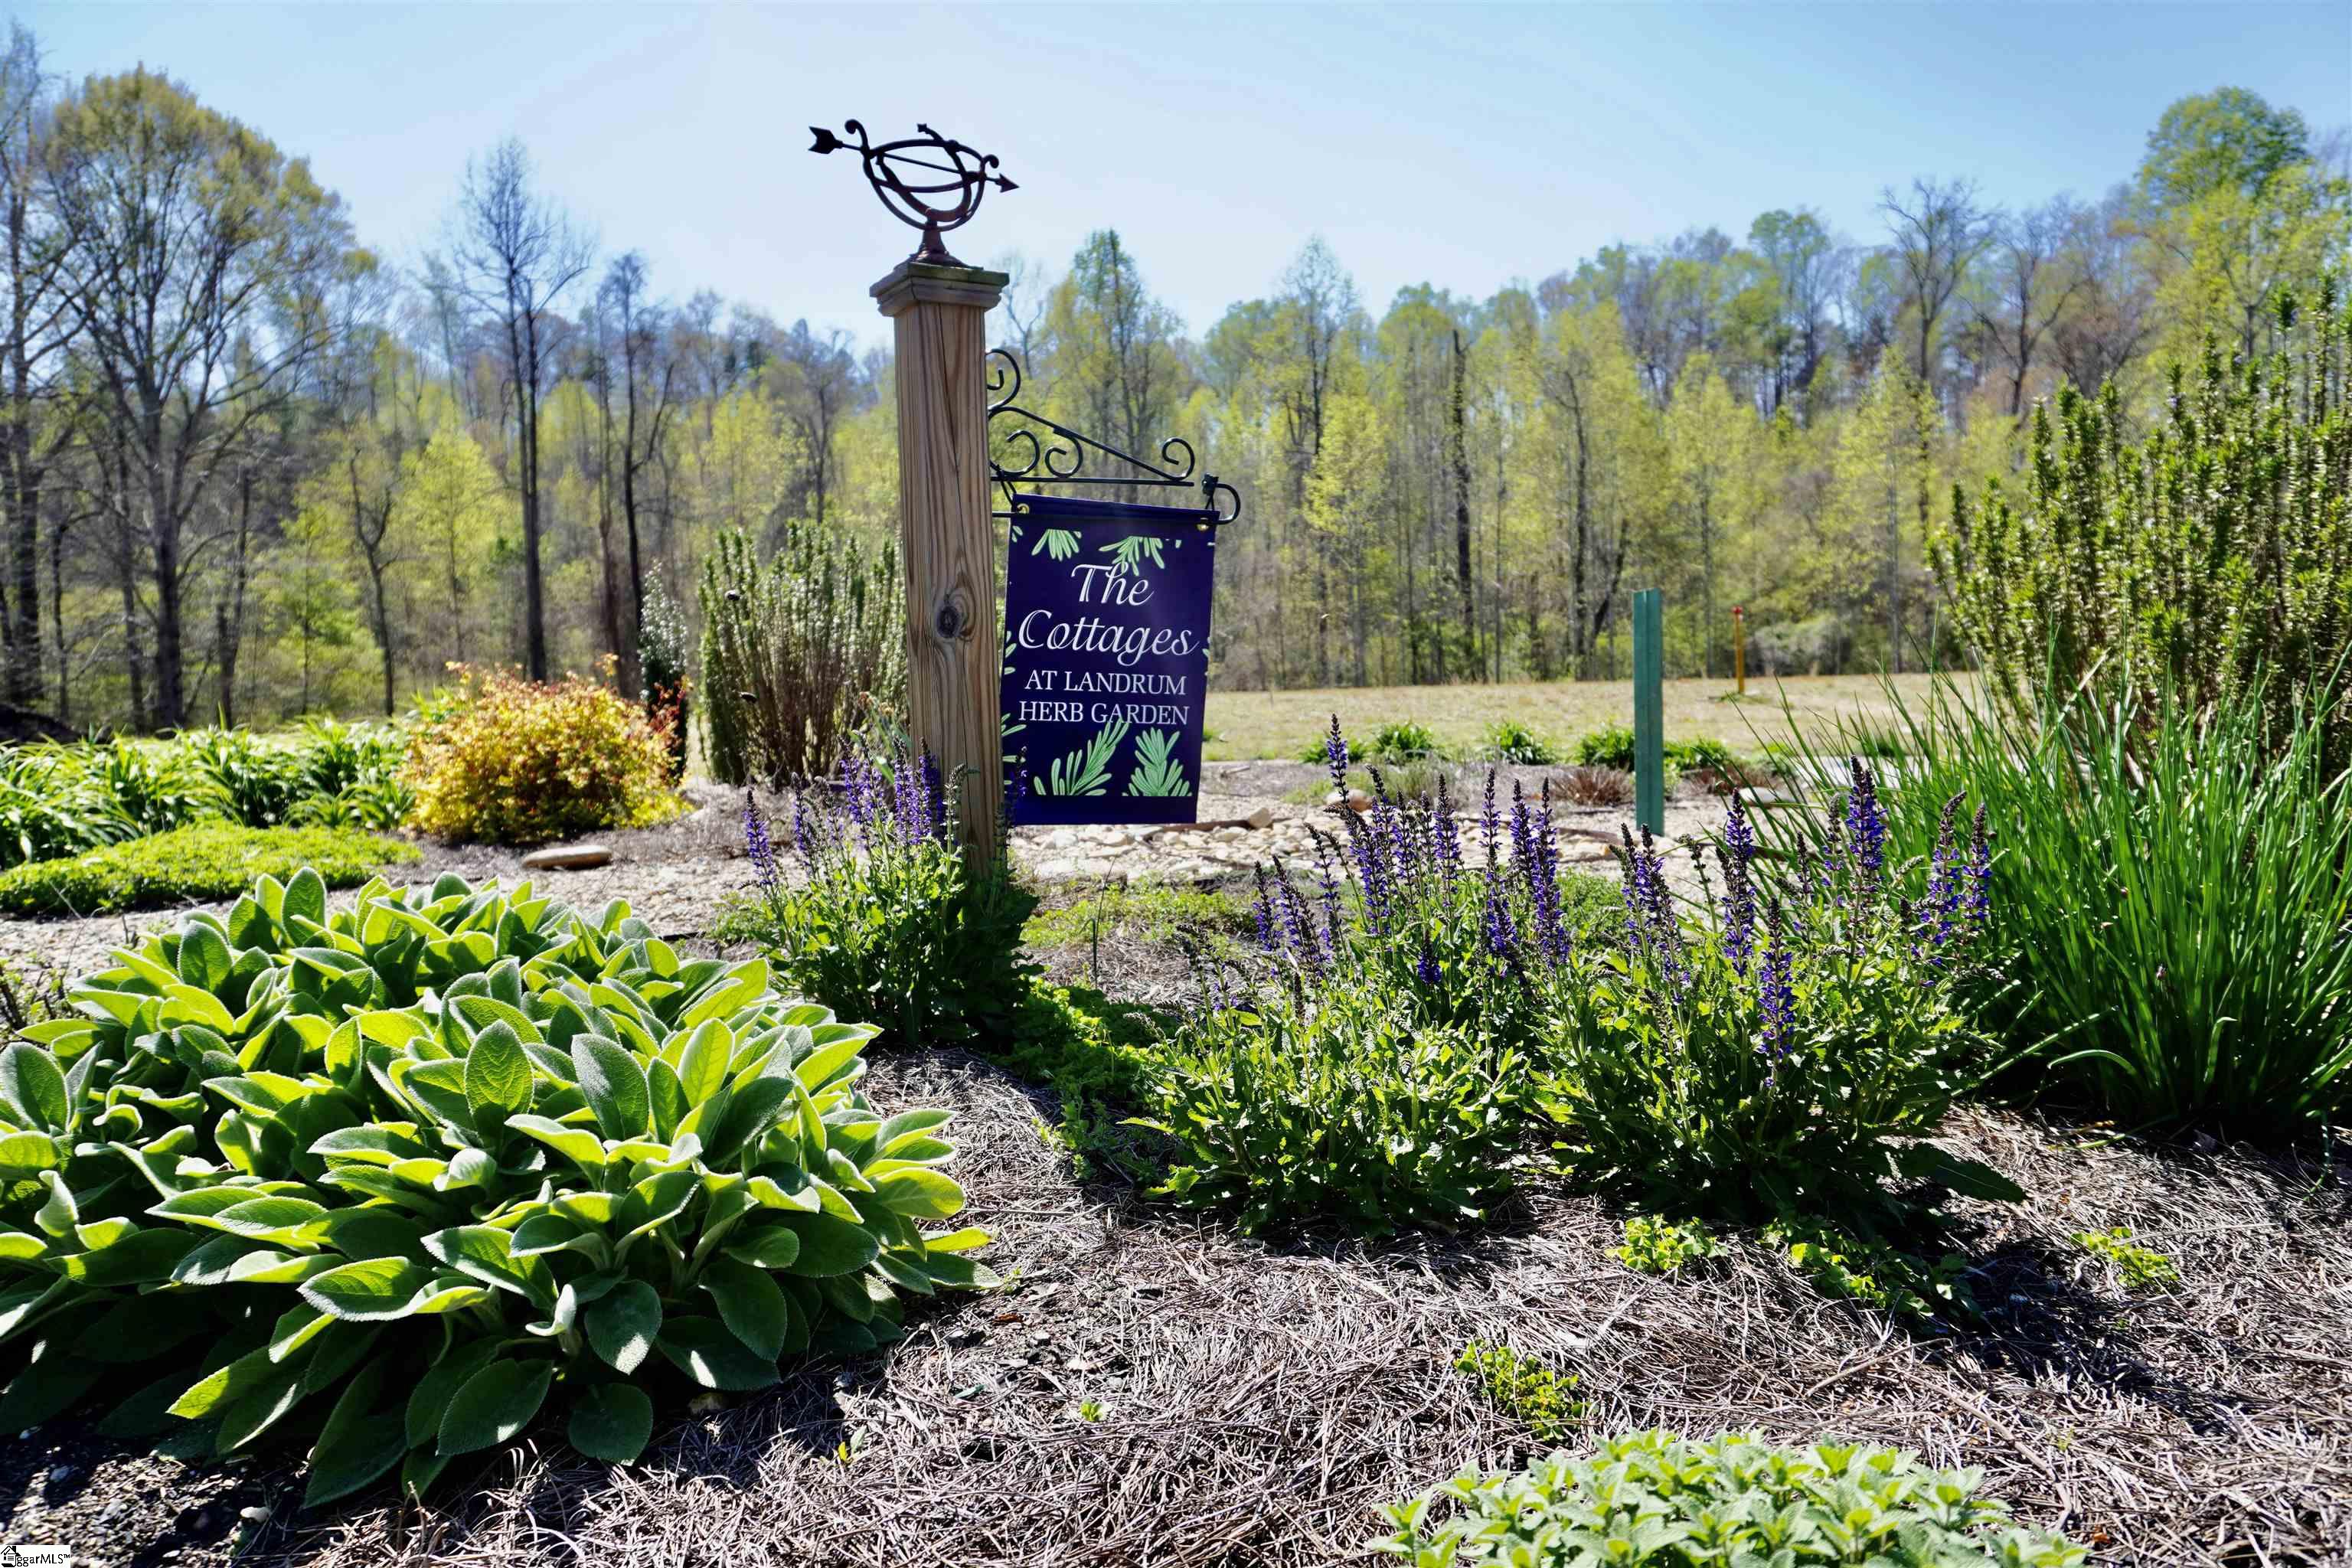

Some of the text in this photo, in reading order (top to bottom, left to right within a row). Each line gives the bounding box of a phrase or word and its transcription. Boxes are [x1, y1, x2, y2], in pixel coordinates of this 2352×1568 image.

[1070, 561, 1155, 606] The
[1018, 609, 1200, 667] Cottages
[1024, 670, 1187, 696] AT LANDRUM
[1018, 701, 1189, 725] HERB GARDEN
